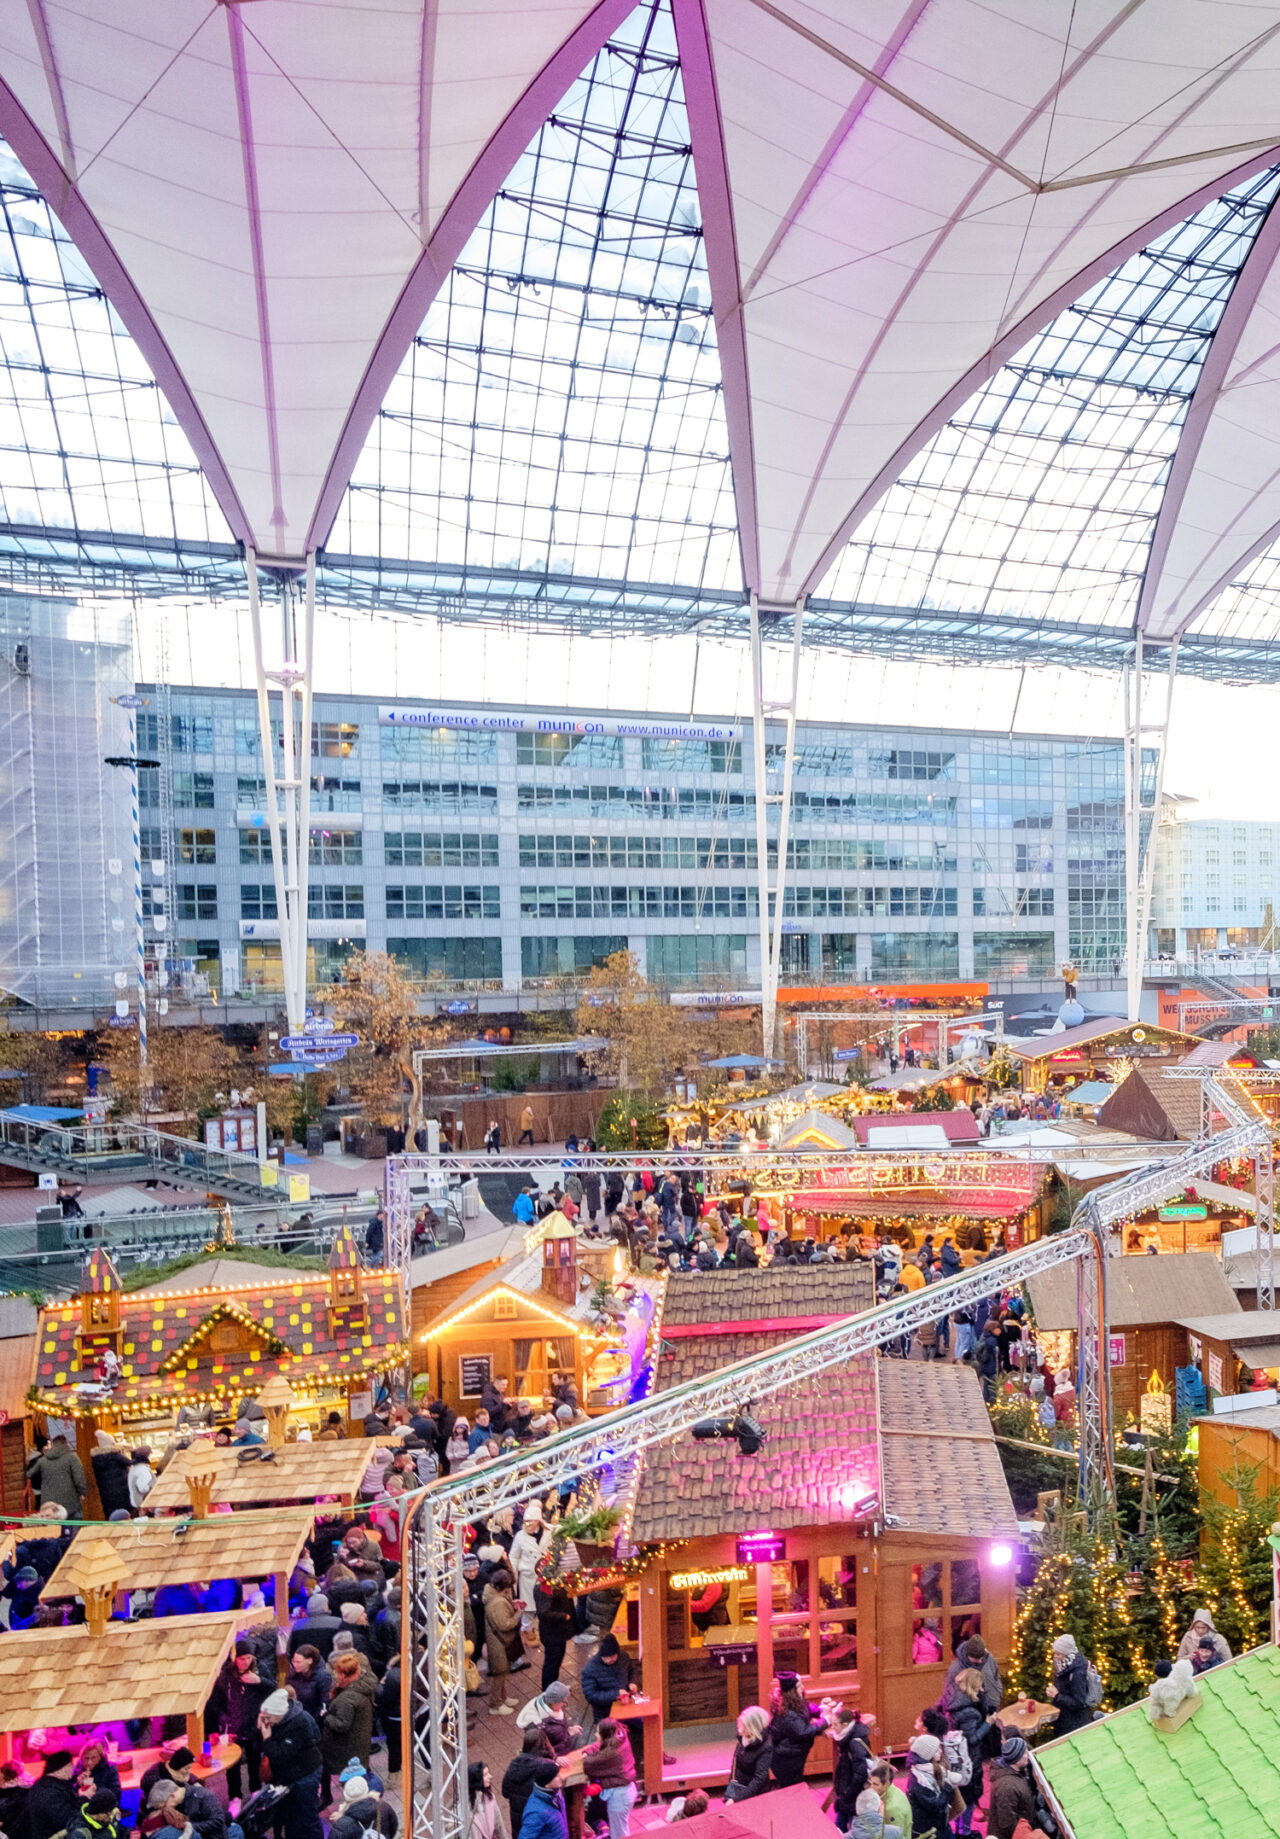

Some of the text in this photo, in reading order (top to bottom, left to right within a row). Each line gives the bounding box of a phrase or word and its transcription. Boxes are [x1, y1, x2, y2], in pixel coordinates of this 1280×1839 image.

[402, 711, 722, 738] conference center municon www.municon.de
[698, 994, 743, 1004] municon
